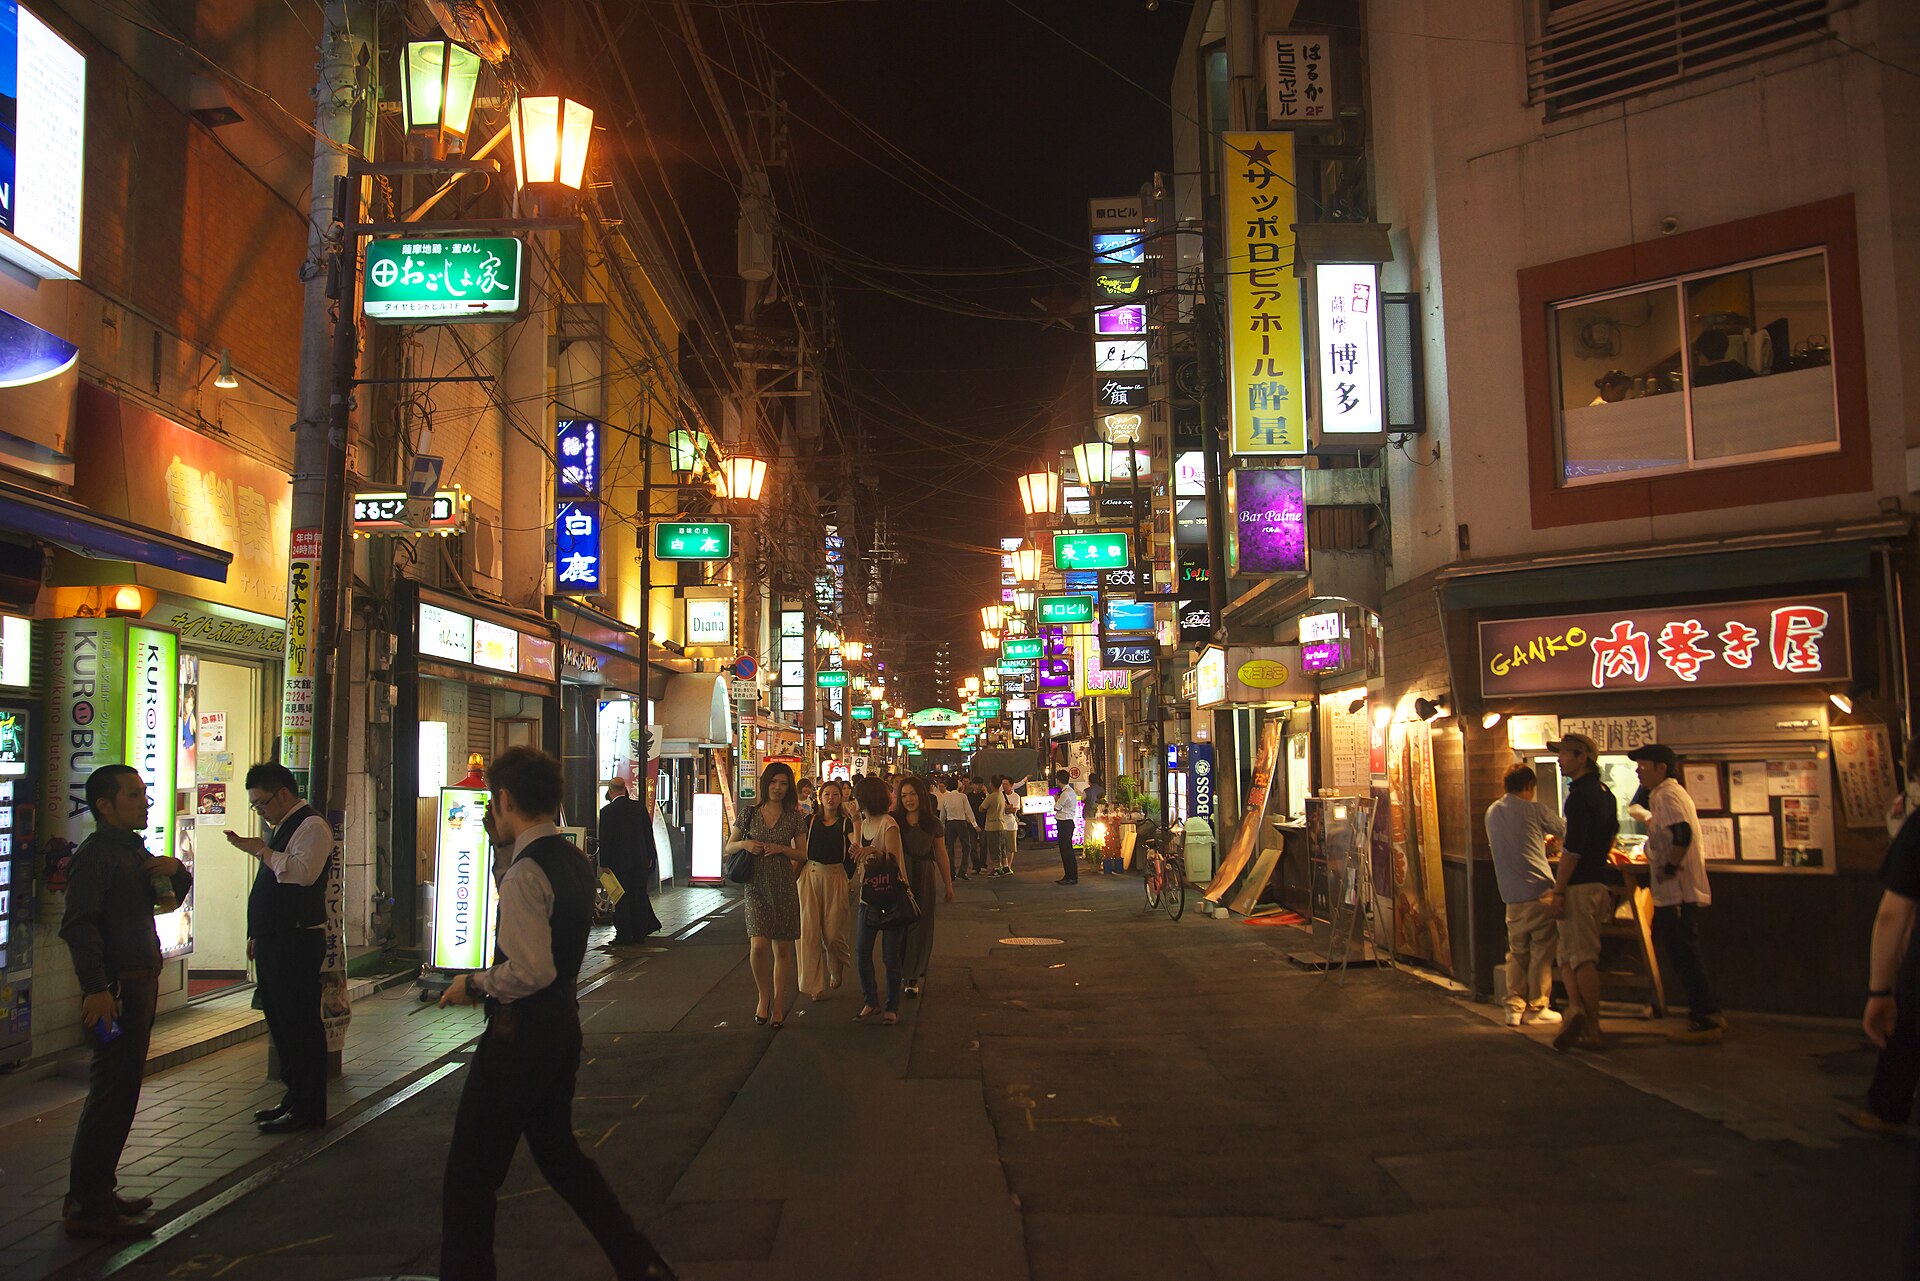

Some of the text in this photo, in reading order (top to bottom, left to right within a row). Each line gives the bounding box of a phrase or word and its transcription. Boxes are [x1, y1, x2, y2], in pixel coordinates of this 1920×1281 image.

[1276, 40, 1298, 116] ヒロミヤビル
[1302, 44, 1324, 102] ぱるか
[1305, 106, 1324, 116] 2F
[1329, 343, 1360, 415] 博多
[1239, 508, 1302, 522] Bar Palme
[559, 509, 597, 583] 白鹿
[693, 616, 725, 633] Diana
[1490, 605, 1829, 689] GANKO 肉巻き屋
[285, 679, 314, 690] 天文館
[1196, 776, 1210, 815] BOSS
[455, 850, 471, 947] KUROBUTA
